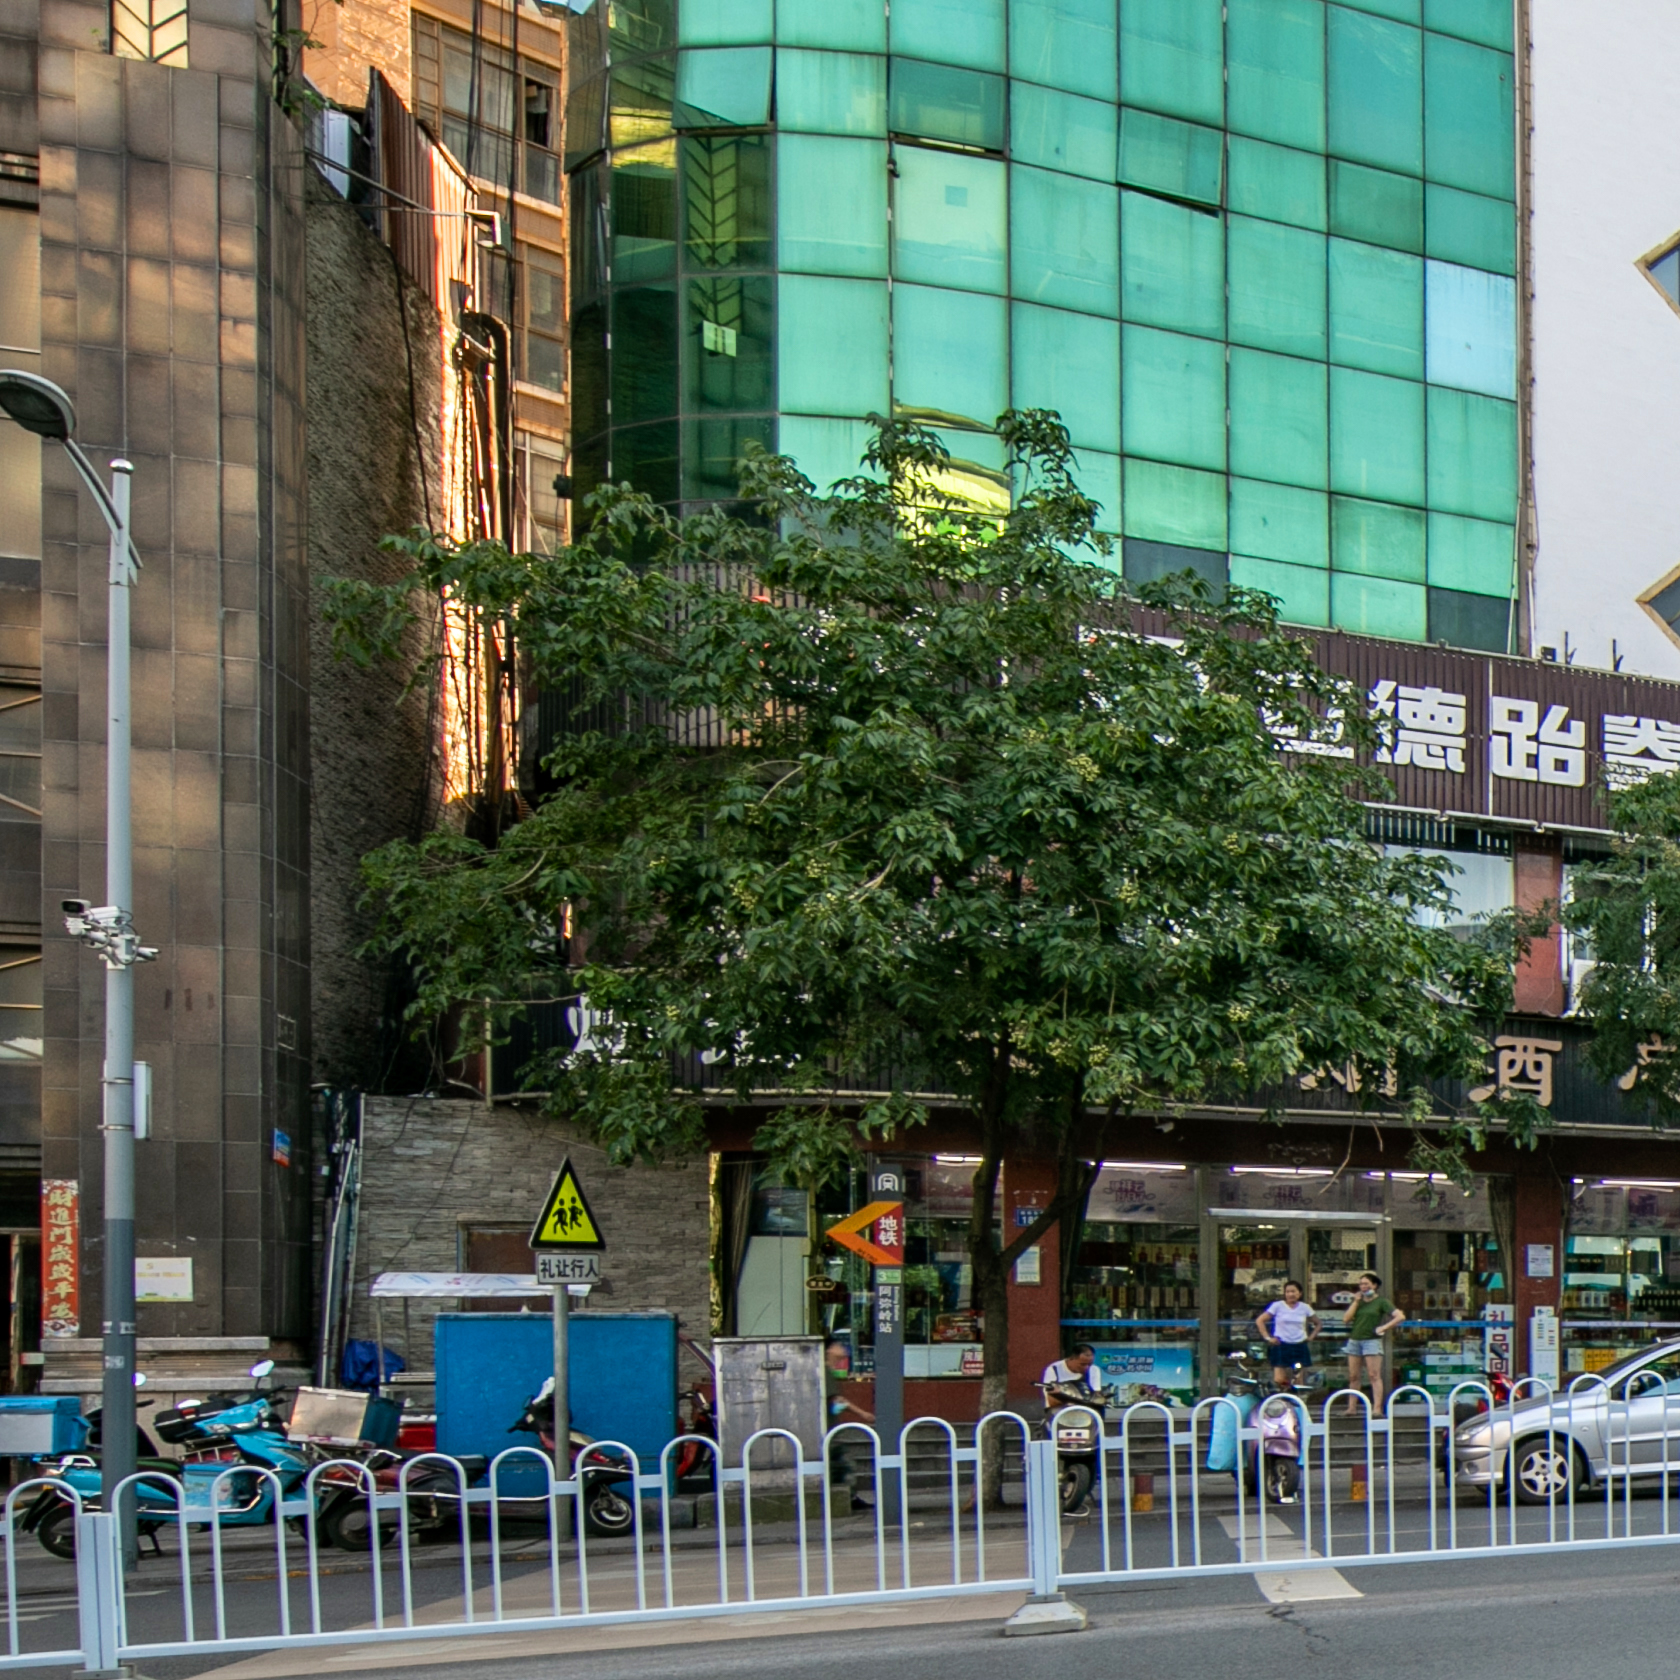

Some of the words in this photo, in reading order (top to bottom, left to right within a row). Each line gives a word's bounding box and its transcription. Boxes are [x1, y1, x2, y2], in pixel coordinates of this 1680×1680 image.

[878, 1215, 899, 1247] 地铁
[540, 1258, 598, 1279] 礼让行人
